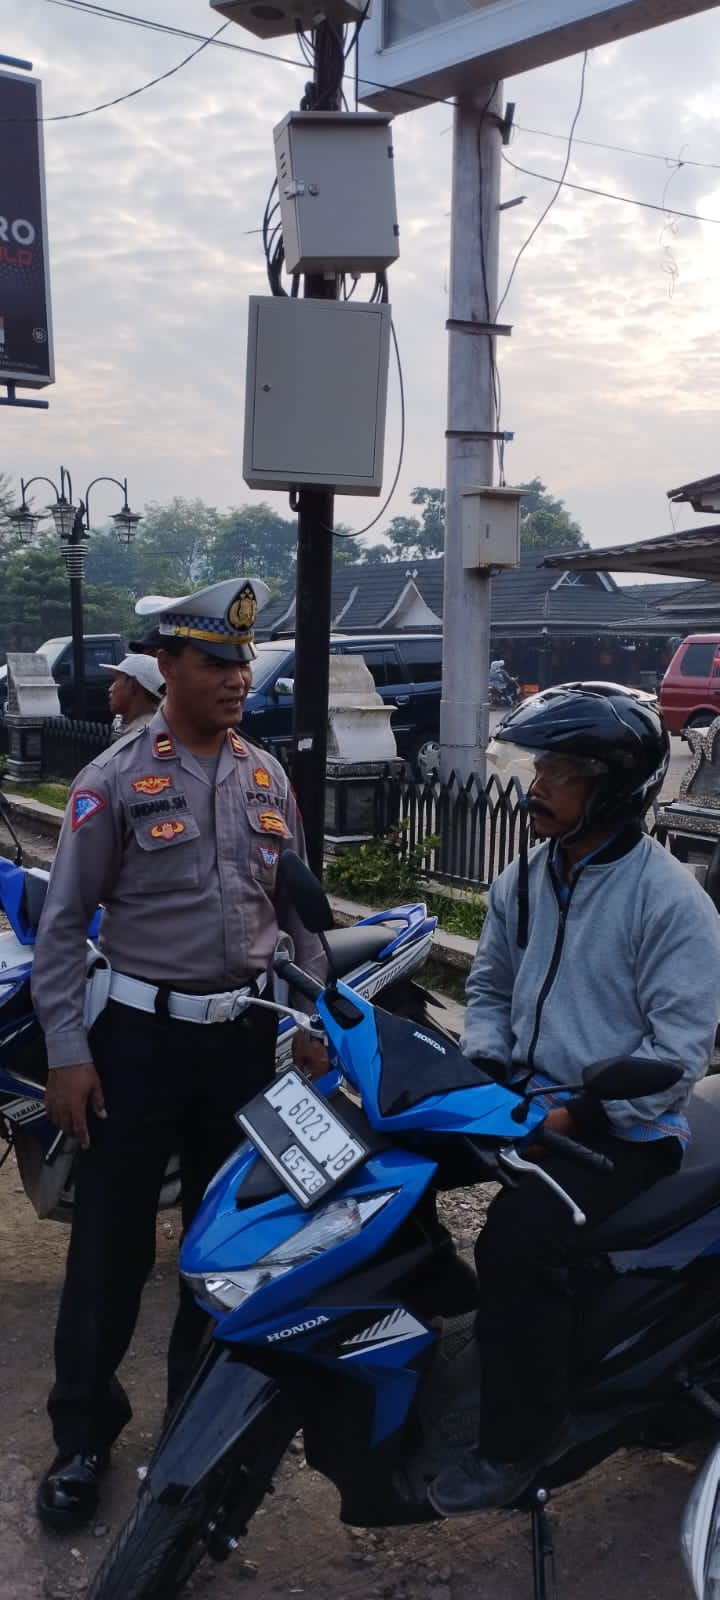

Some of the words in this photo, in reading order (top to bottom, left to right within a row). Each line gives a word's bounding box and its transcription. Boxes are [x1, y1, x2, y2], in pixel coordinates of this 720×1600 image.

[412, 1031, 446, 1055] HONDA
[12, 1102, 41, 1119] YAMAHA
[273, 1078, 294, 1097] T
[288, 1098, 331, 1143] 6023
[326, 1143, 356, 1172] JB
[266, 1315, 330, 1342] HONDA
